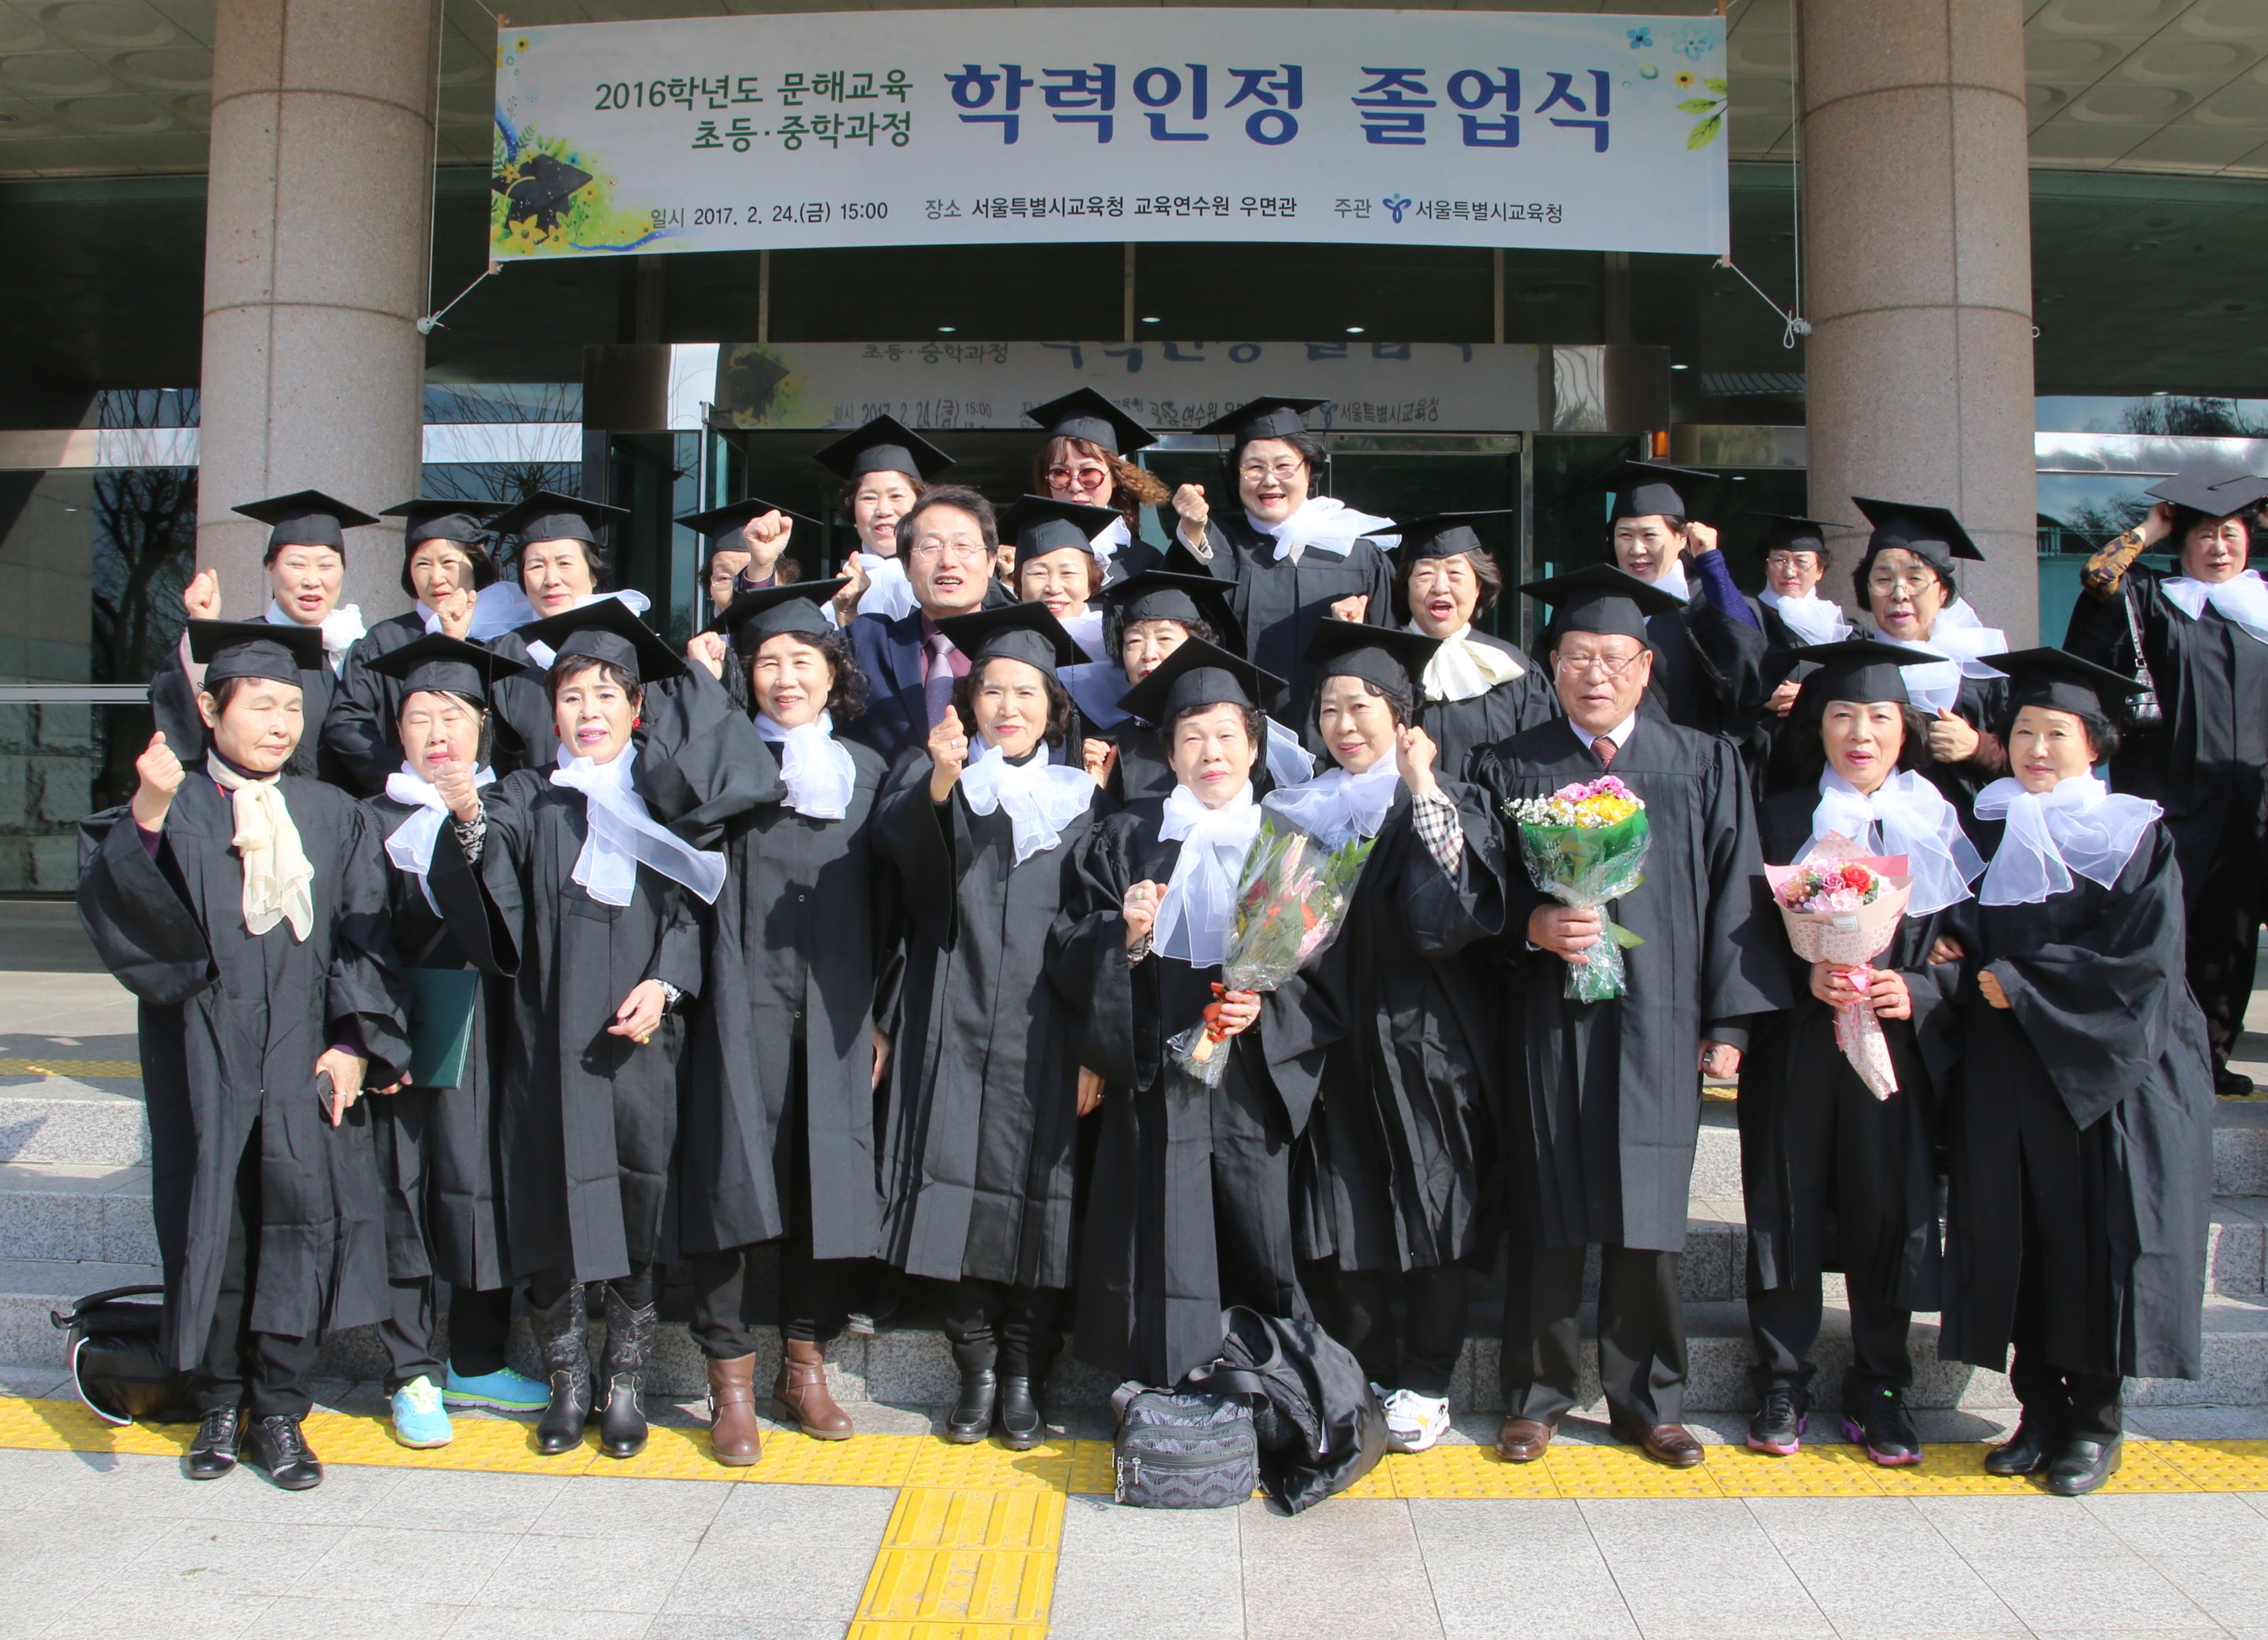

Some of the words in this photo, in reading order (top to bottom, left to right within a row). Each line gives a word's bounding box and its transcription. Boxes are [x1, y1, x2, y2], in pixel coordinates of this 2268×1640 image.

[595, 75, 763, 111] 2016학년도
[777, 69, 913, 106] 문해교육
[944, 63, 1302, 146] 학력인정
[1351, 66, 1610, 153] 졸업식
[650, 208, 684, 228] 일시
[694, 207, 738, 226] 2017.
[747, 206, 763, 225] 2.
[772, 201, 831, 224] 24.(금)
[840, 202, 888, 220] 15:00
[925, 199, 962, 220] 장소
[972, 196, 1124, 219] 서울특별시교육청
[1134, 196, 1229, 217] 교육연수원
[1239, 197, 1298, 217] 우면관
[1333, 199, 1372, 219] 주관
[1415, 200, 1562, 224] 서울특별시교육청
[965, 402, 991, 418] 15:00
